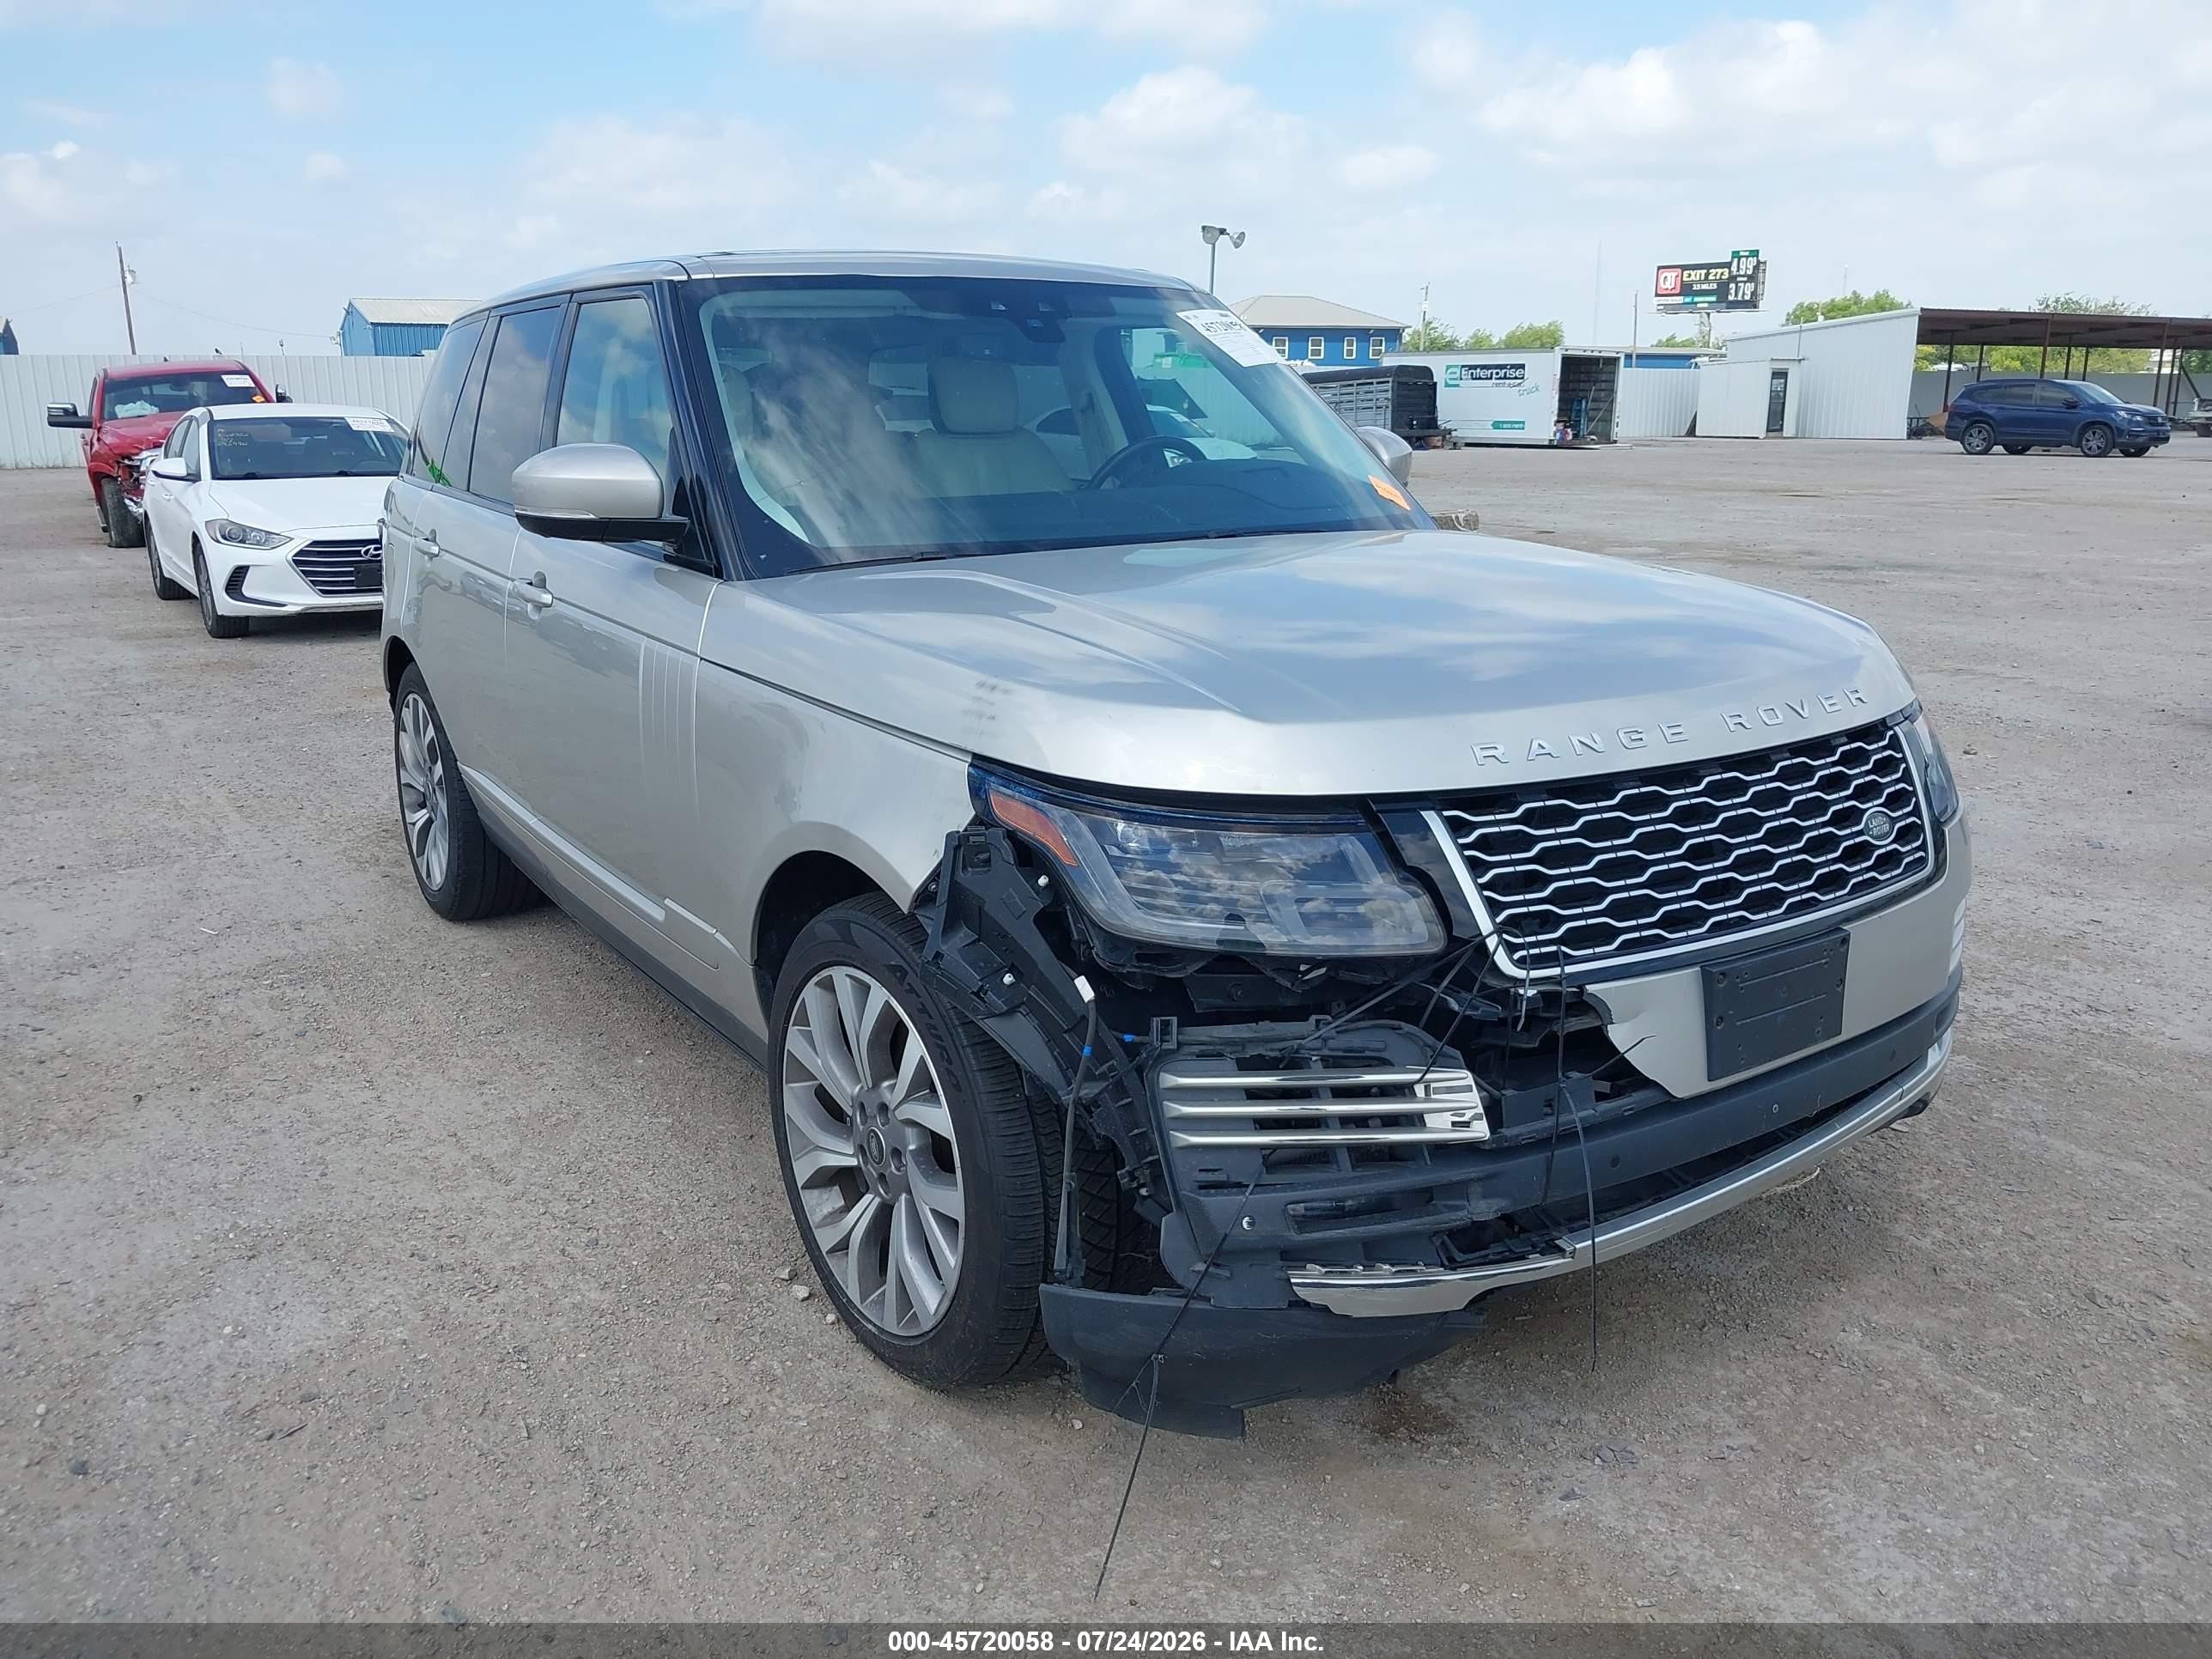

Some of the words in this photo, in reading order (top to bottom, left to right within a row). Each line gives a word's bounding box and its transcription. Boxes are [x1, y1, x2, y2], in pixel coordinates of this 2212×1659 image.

[1659, 271, 1679, 291] QT
[1682, 270, 1705, 281] EXIT
[1708, 268, 1729, 280] 273
[1462, 366, 1524, 381] Enterprise
[1517, 382, 1540, 397] truck
[1470, 721, 1689, 766] RANGE
[1720, 687, 1869, 732] ROVER
[1869, 817, 1887, 828] LAND
[1873, 824, 1890, 836] ROVER
[883, 963, 963, 1094] ATTURO
